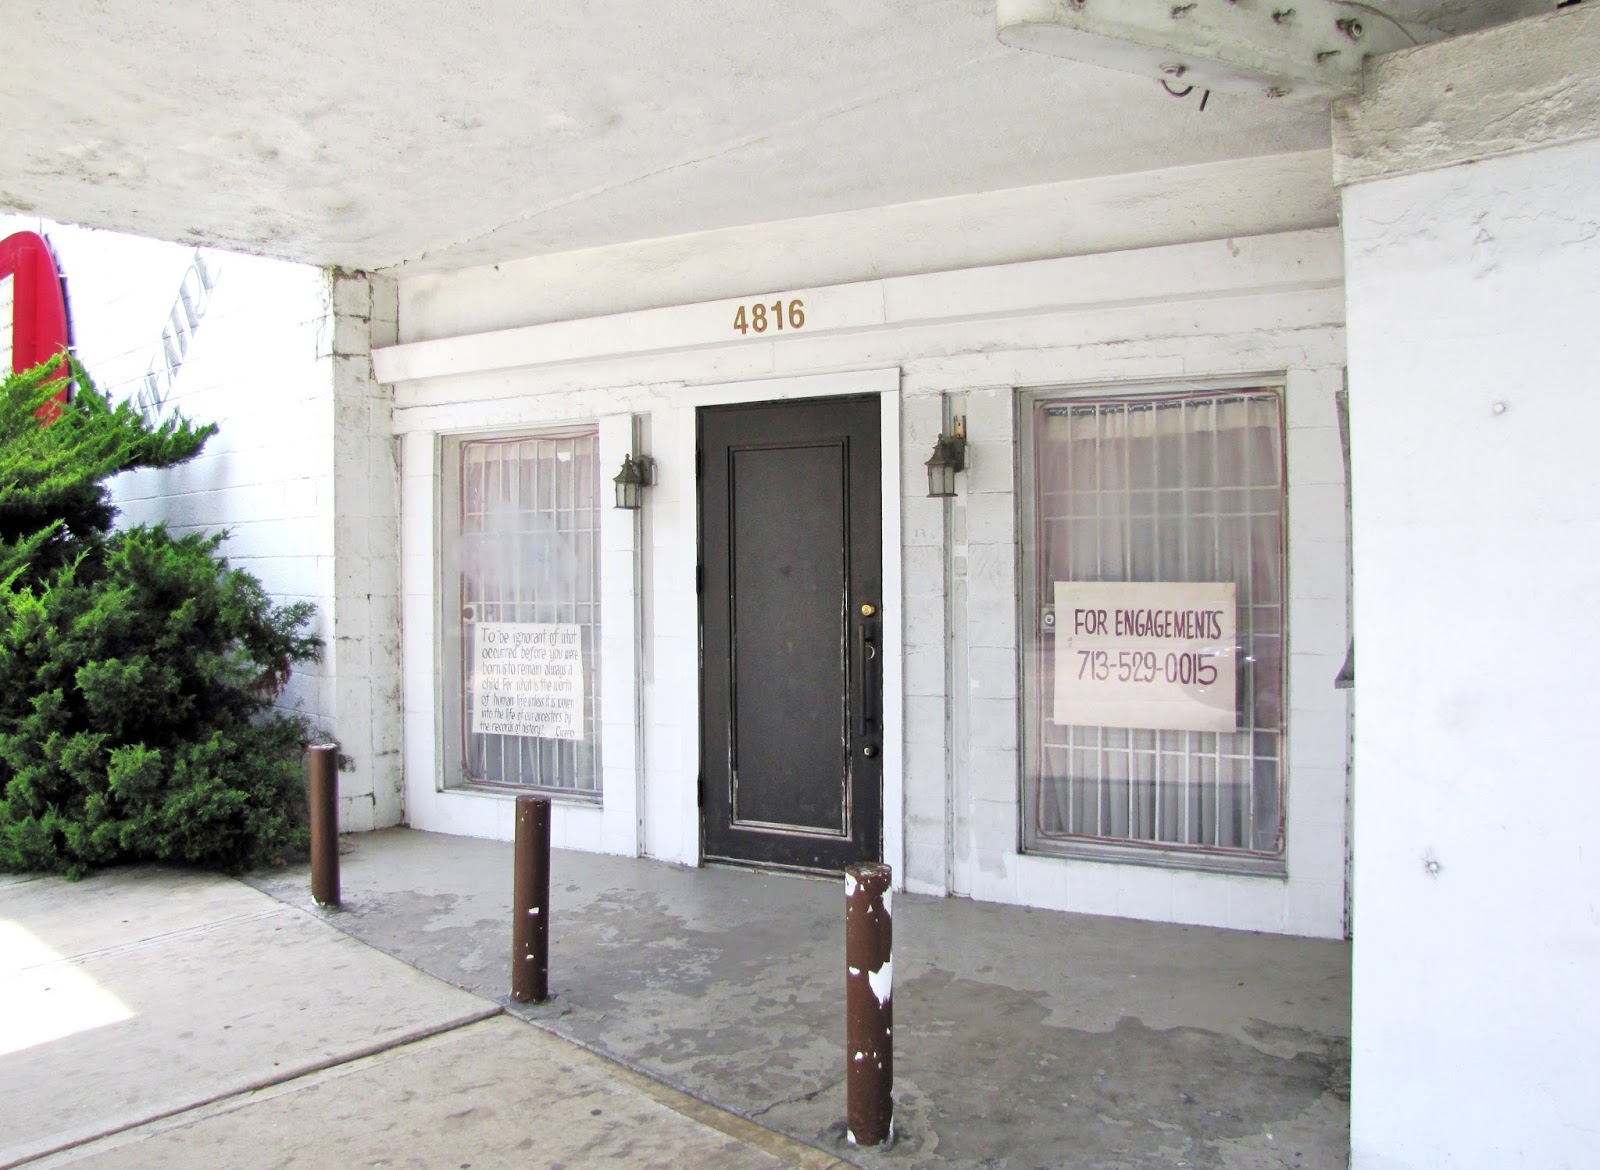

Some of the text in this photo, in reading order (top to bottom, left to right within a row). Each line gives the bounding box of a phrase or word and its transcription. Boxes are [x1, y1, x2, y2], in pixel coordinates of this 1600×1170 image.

[734, 299, 805, 335] 4816
[1074, 608, 1224, 640] FOR ENGAGEMENTS
[481, 628, 576, 647] To be ignorant of what
[482, 646, 578, 662] occurred before you were
[483, 662, 572, 677] born is to remain always a
[1077, 650, 1218, 686] 713-529-0015
[503, 678, 512, 690] For
[517, 678, 532, 690] what
[533, 678, 538, 690] is
[541, 678, 551, 691] the
[554, 678, 571, 691] worth
[481, 692, 574, 709] of human life unless it is woven
[482, 708, 571, 725] into the life of our ancestors by
[480, 721, 489, 731] the
[492, 722, 513, 732] records
[515, 722, 520, 734] of
[556, 726, 574, 737] Cicero
